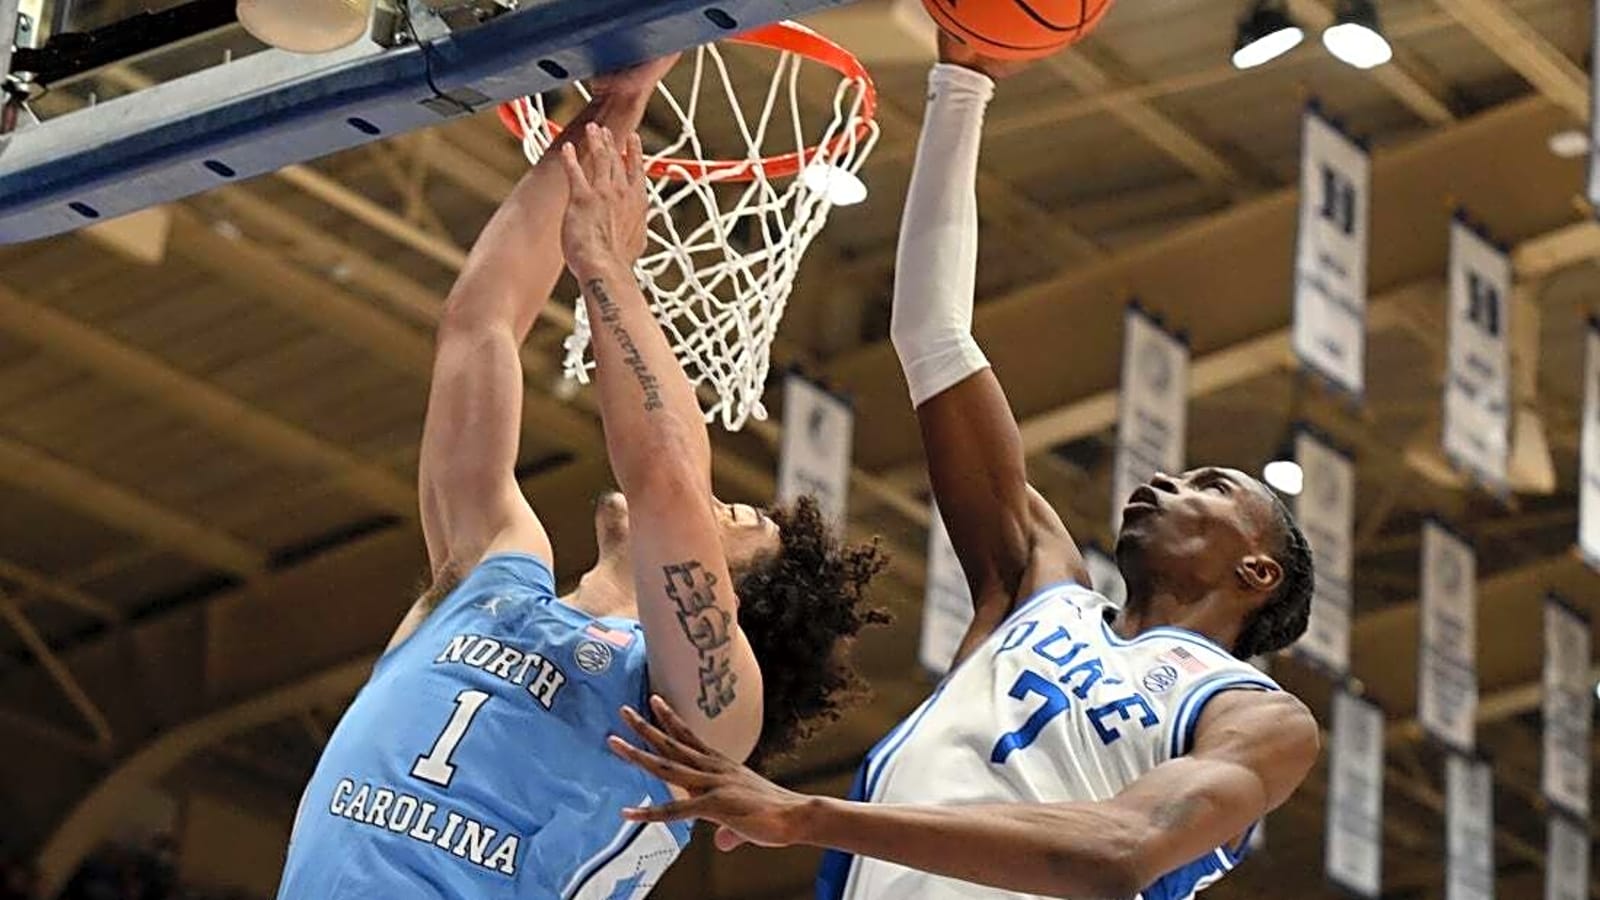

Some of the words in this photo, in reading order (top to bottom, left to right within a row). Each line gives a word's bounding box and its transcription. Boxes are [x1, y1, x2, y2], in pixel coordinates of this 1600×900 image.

[435, 634, 567, 710] NORTH
[990, 669, 1070, 763] 7
[1000, 620, 1160, 745] DUKE
[410, 689, 491, 787] 1
[329, 778, 520, 875] CAROLINA
